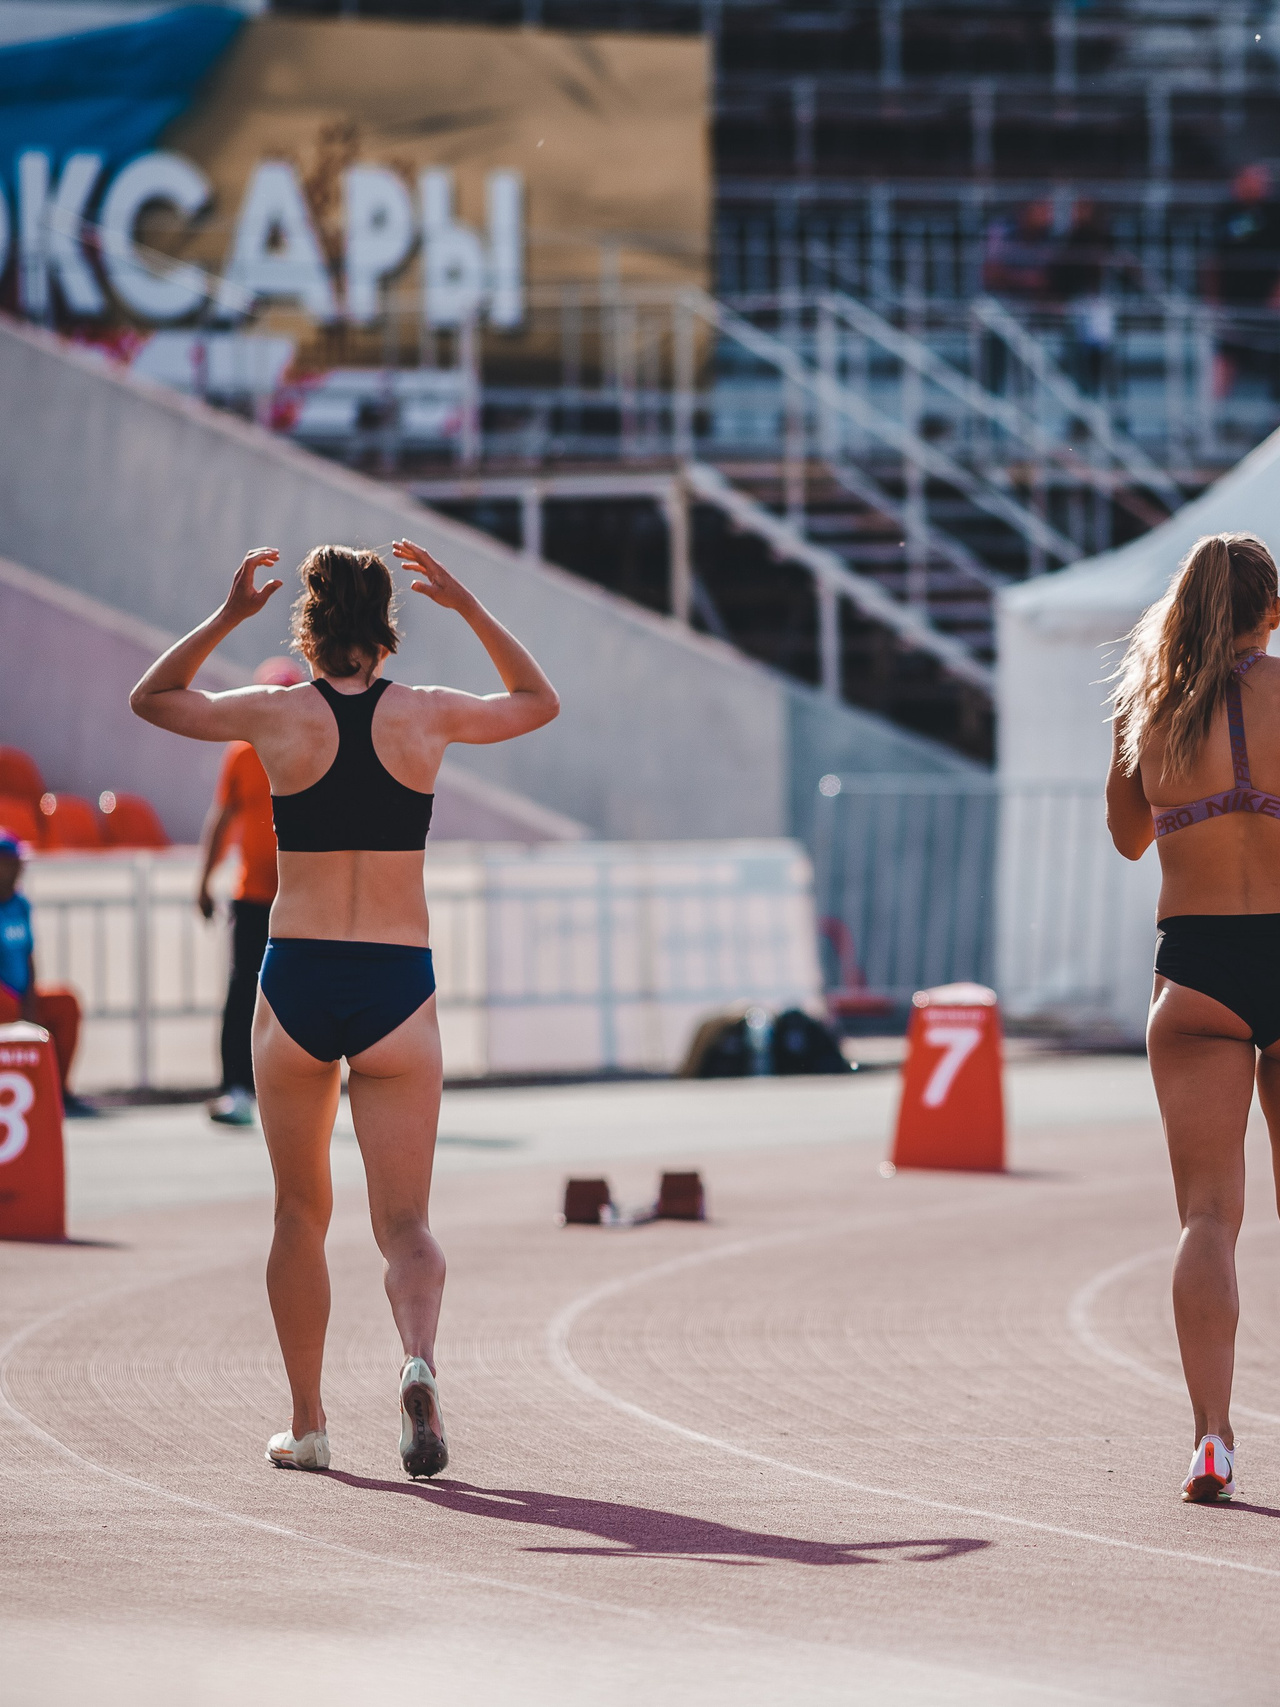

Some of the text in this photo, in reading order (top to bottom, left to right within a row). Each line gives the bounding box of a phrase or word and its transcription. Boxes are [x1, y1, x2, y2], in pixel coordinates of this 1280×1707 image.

[0, 150, 525, 333] КСАРЫ
[1227, 685, 1243, 727] NIK
[1155, 809, 1194, 837] PRO
[924, 1026, 981, 1108] 7
